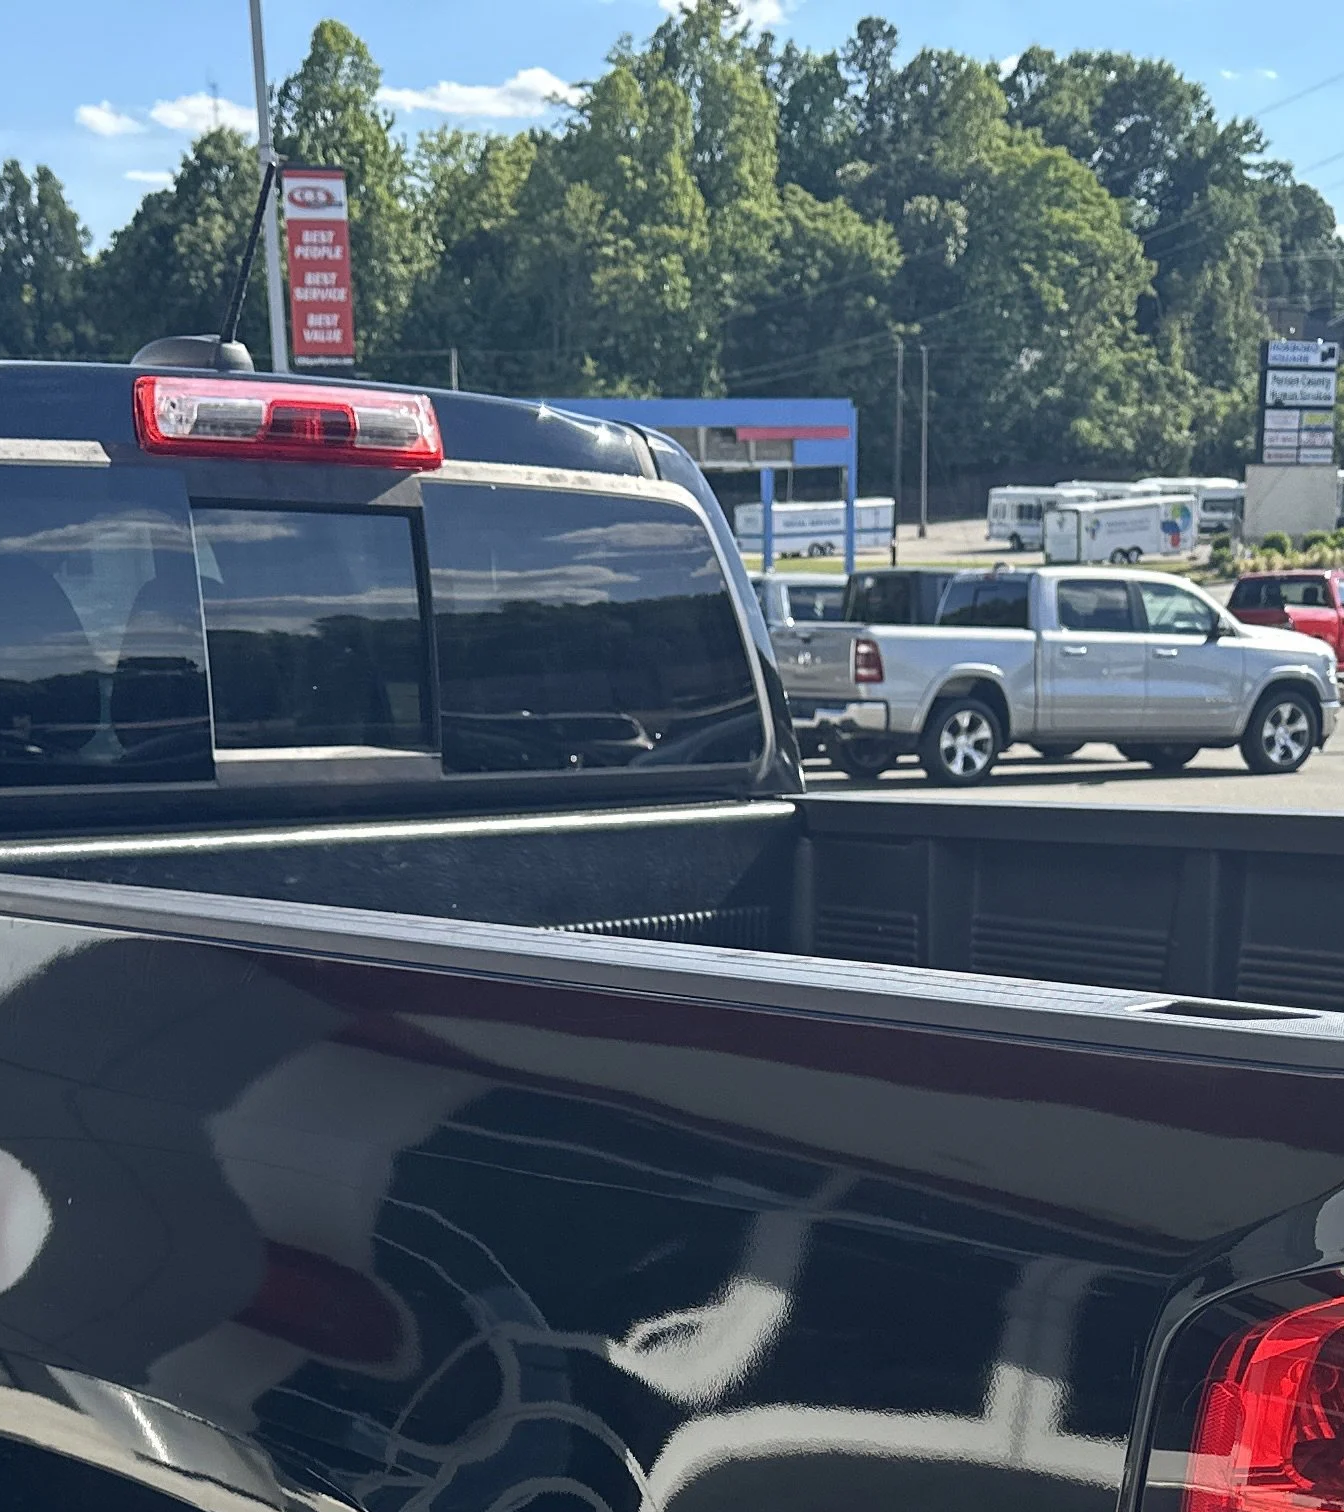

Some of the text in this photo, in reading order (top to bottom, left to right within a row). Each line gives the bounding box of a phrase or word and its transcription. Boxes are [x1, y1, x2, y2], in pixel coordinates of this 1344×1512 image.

[301, 230, 336, 245] BEST
[294, 245, 344, 260] PEOPLE
[304, 271, 338, 287] BEST
[293, 287, 348, 302] SERVICE
[306, 313, 340, 328] BEST
[302, 328, 344, 344] VALUE
